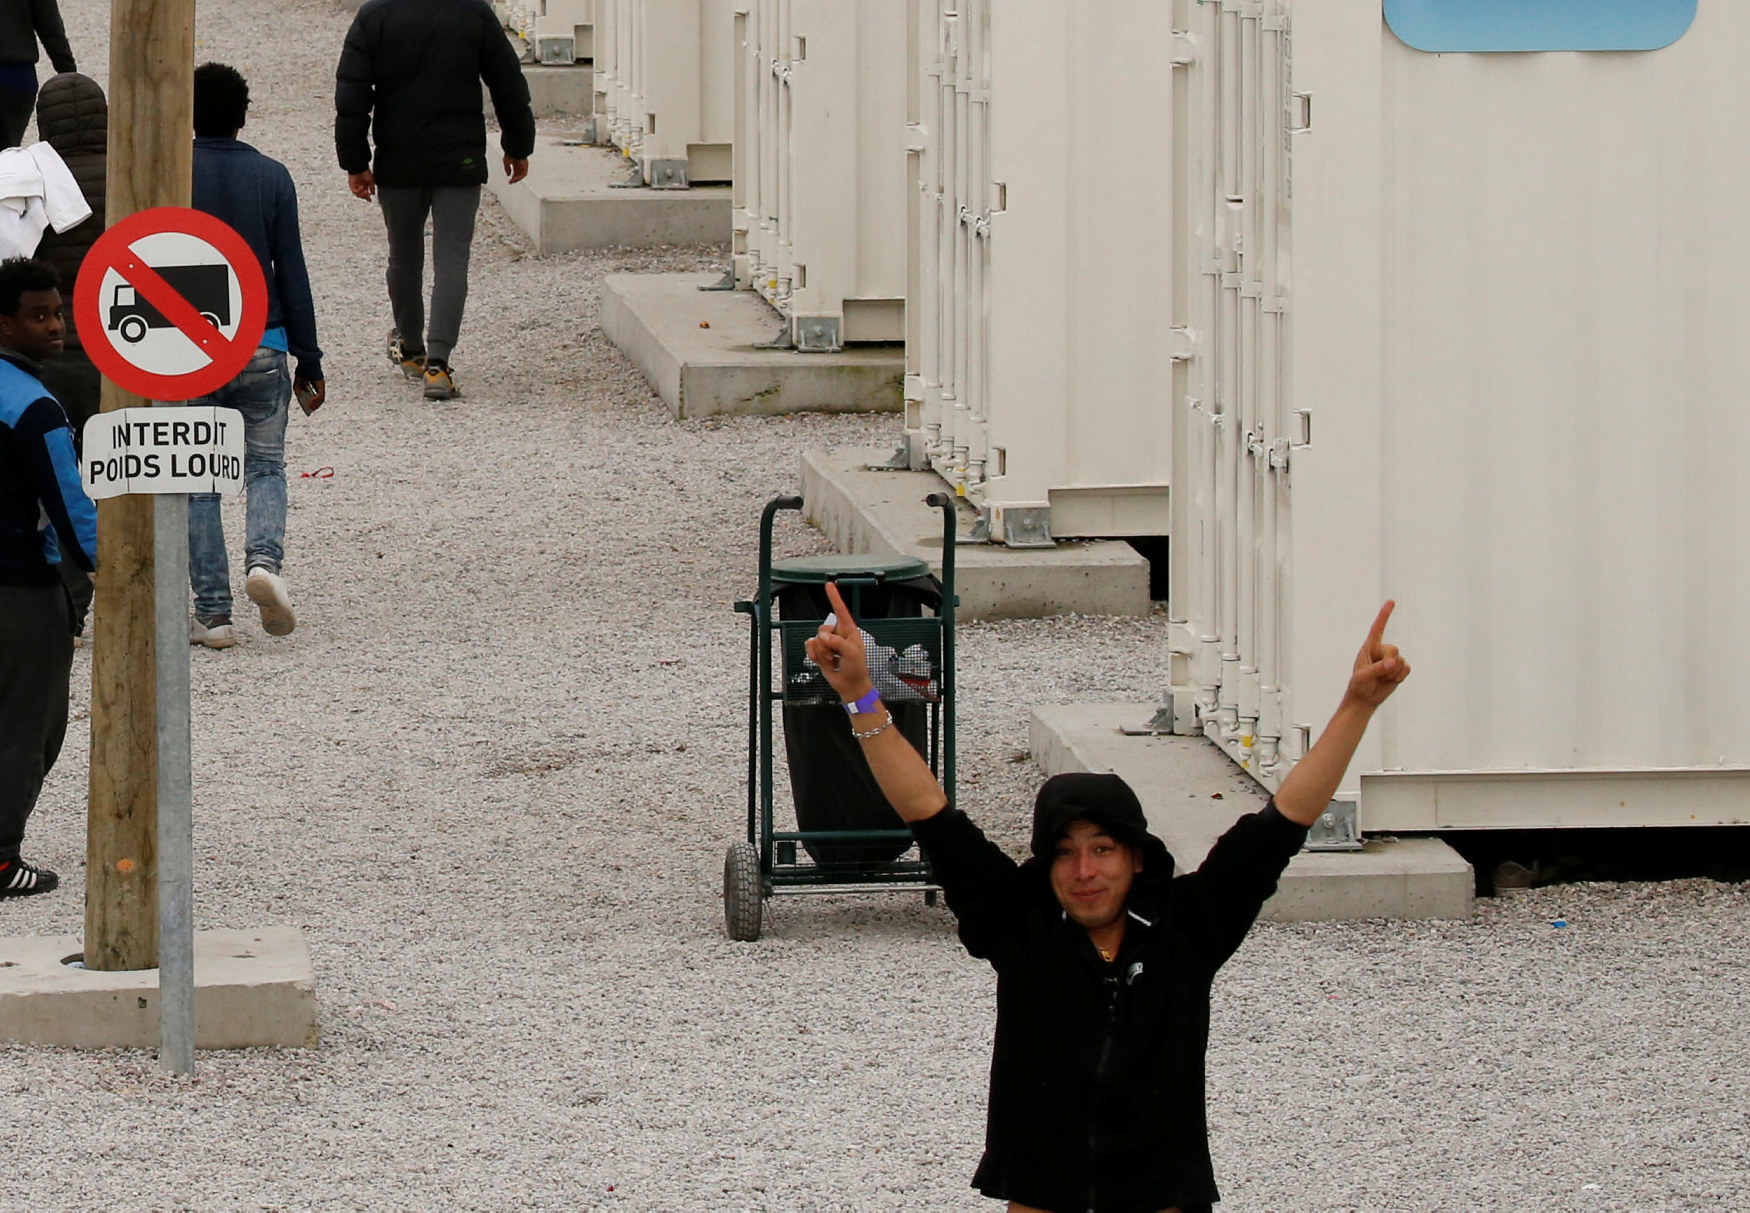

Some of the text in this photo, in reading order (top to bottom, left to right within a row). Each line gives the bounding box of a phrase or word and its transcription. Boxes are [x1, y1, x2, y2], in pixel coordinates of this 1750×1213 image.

[112, 422, 227, 449] INTERDIT
[90, 454, 240, 484] POIDS LOURD
